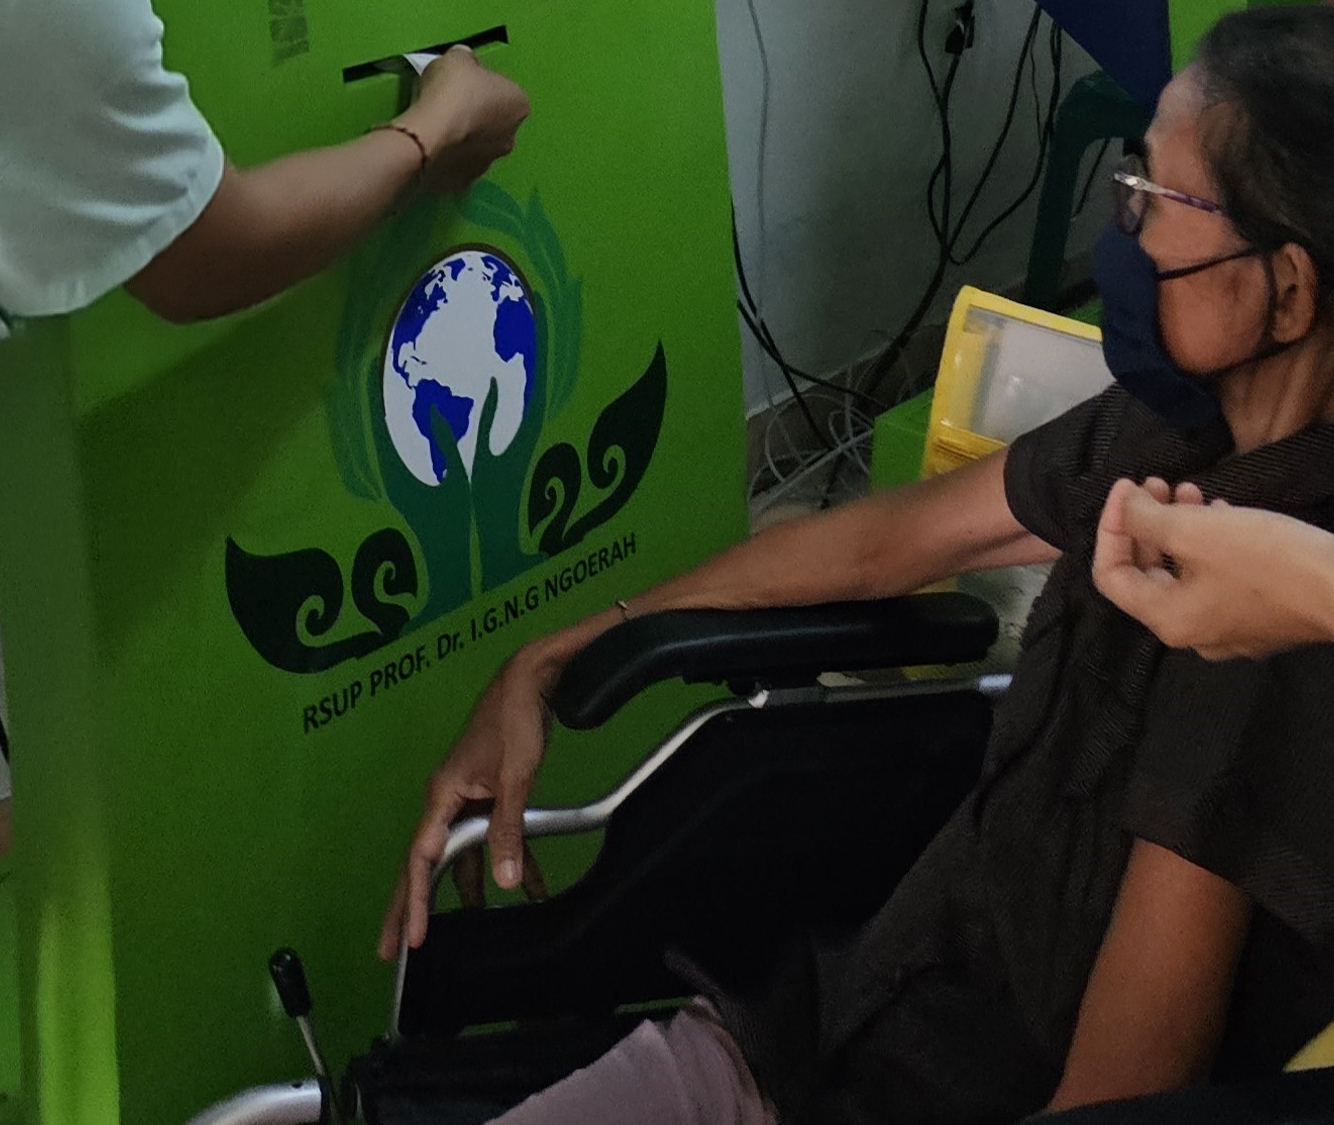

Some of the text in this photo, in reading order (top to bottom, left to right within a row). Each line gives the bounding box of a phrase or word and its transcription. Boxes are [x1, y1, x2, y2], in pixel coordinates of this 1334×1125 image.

[303, 531, 637, 735] RSUP PROF. Dr. I.G.N.G NGOERAH
